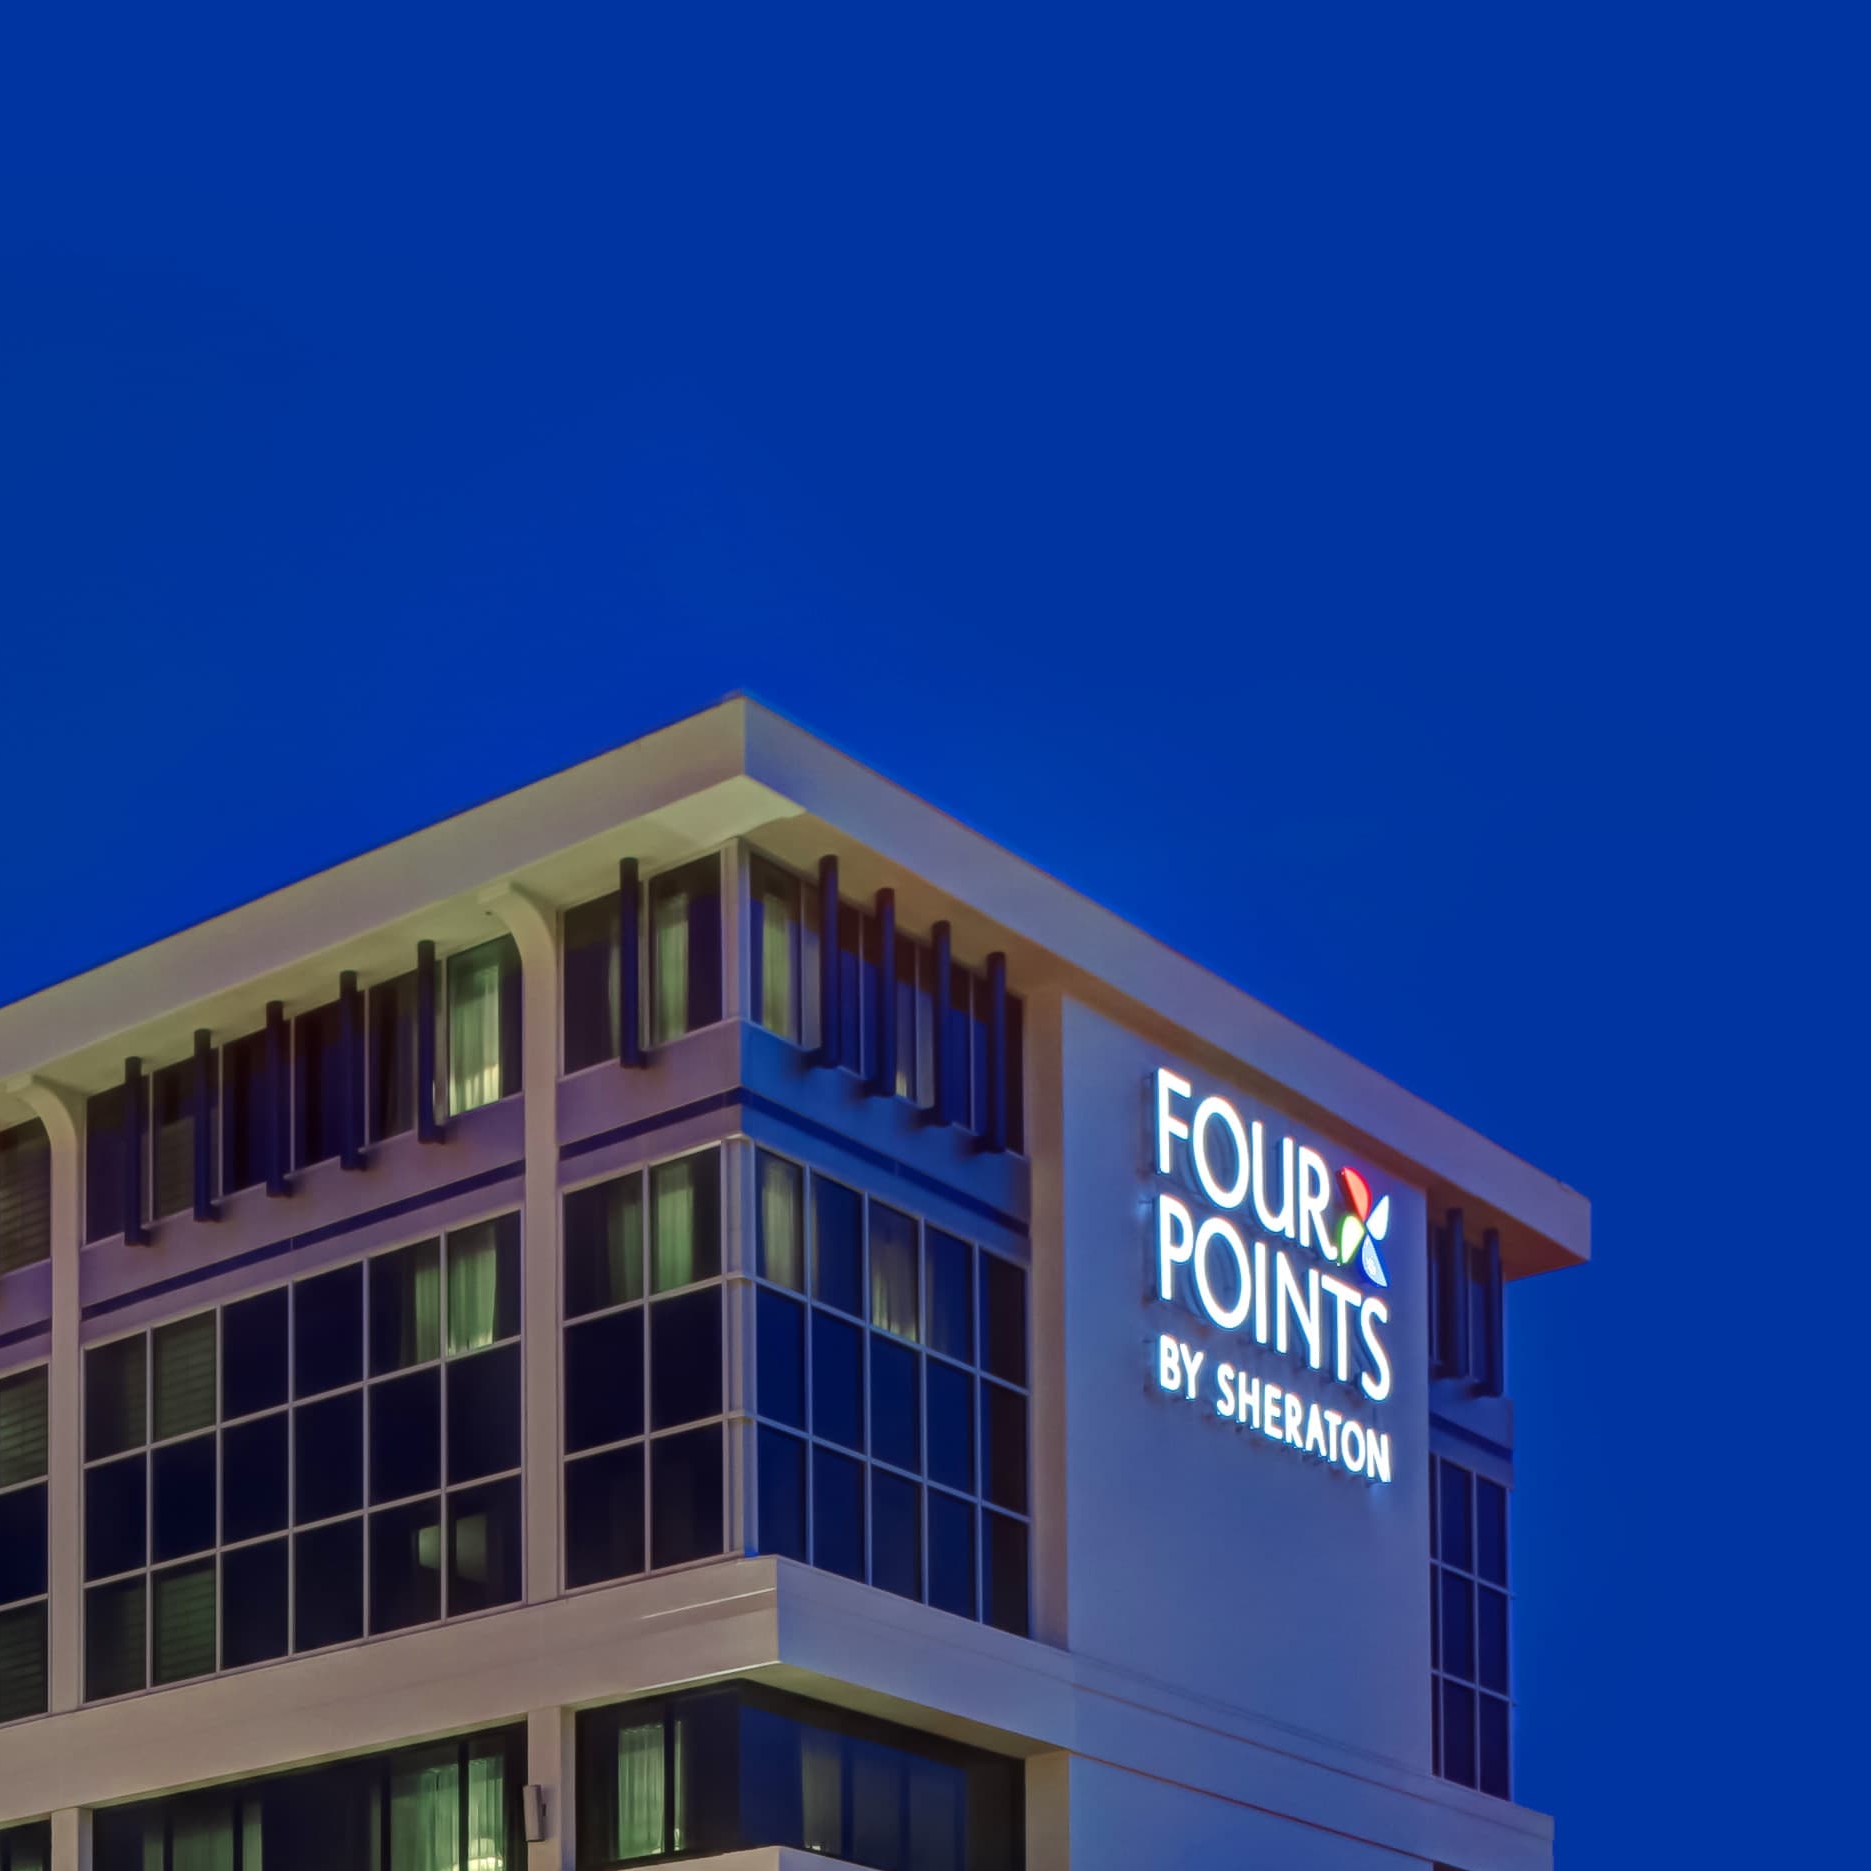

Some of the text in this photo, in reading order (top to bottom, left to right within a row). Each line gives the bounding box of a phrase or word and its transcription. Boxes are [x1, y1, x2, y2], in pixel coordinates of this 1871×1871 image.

[1155, 1067, 1338, 1264] FOUR
[1157, 1193, 1392, 1402] POINTS
[1158, 1334, 1392, 1483] BY SHERATON
